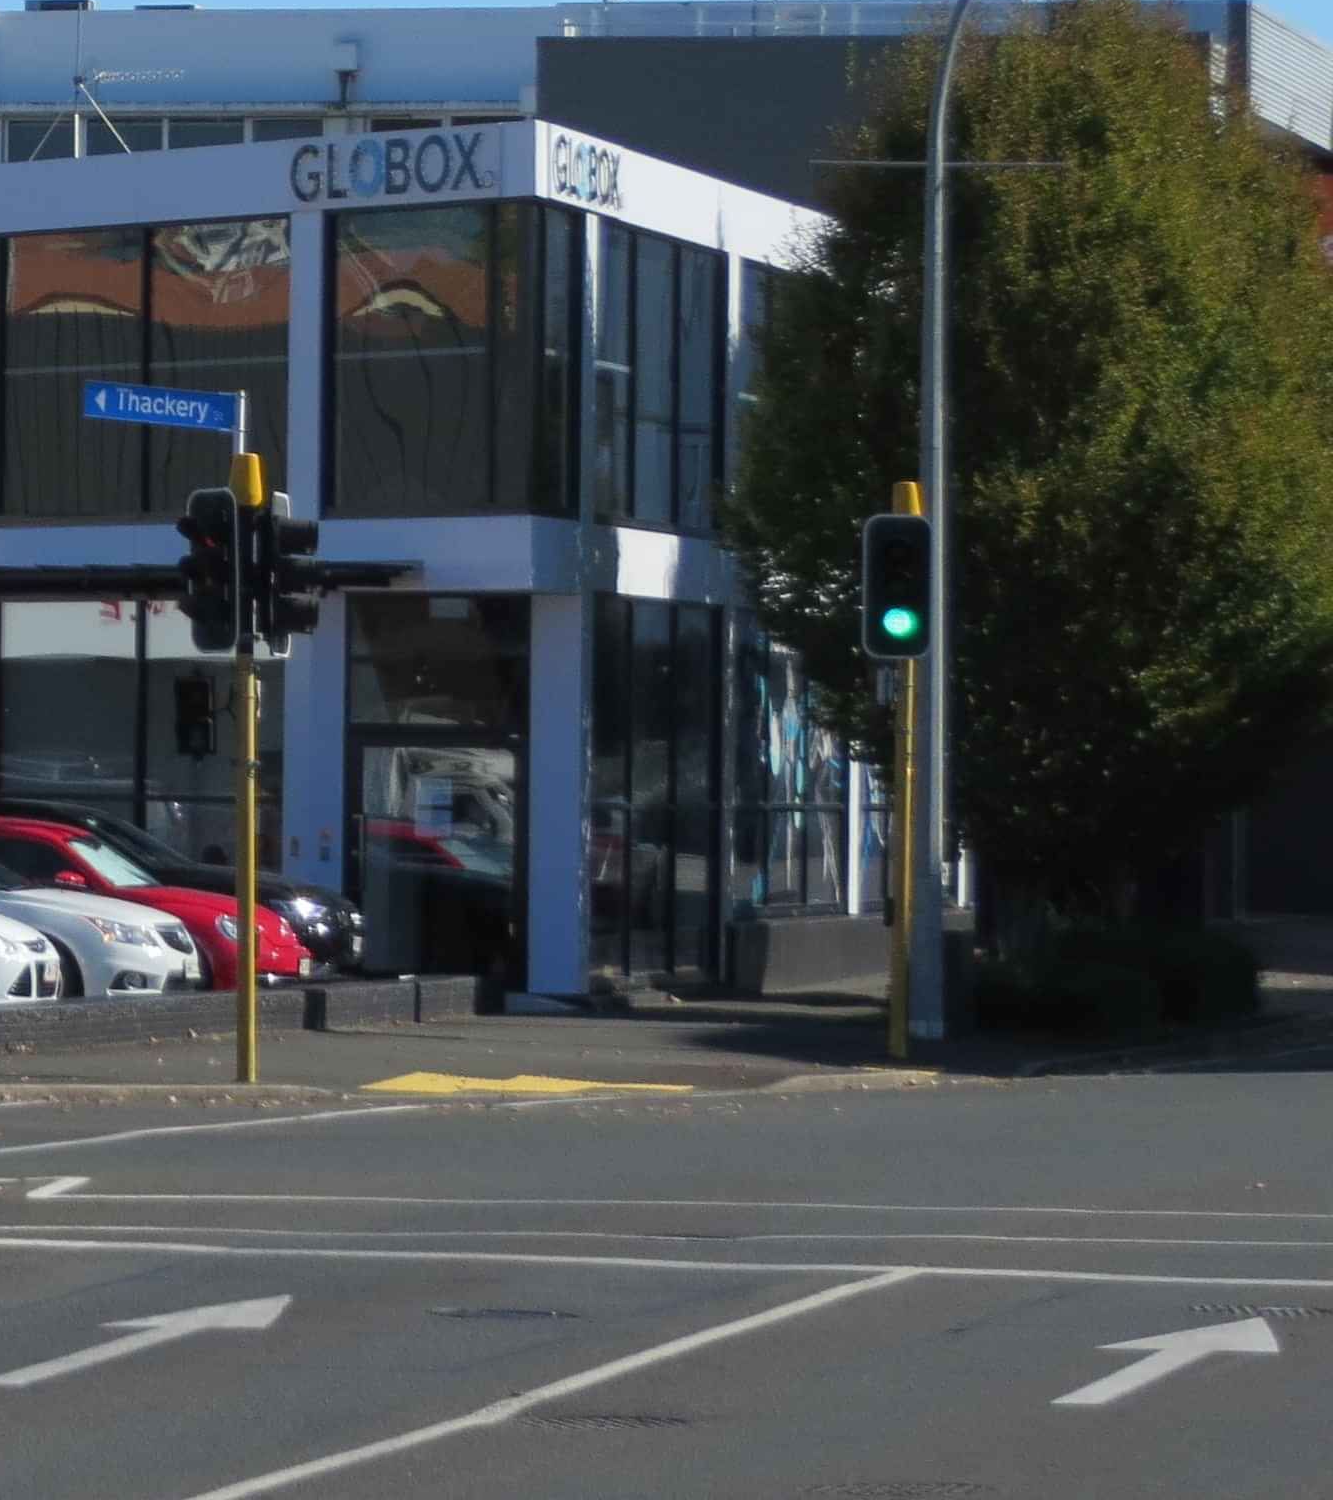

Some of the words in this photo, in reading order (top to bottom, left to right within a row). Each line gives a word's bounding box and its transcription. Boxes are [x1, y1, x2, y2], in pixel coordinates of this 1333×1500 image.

[290, 132, 483, 202] GLOBOX
[553, 133, 623, 211] GLOBOX
[117, 387, 209, 423] Thackery
